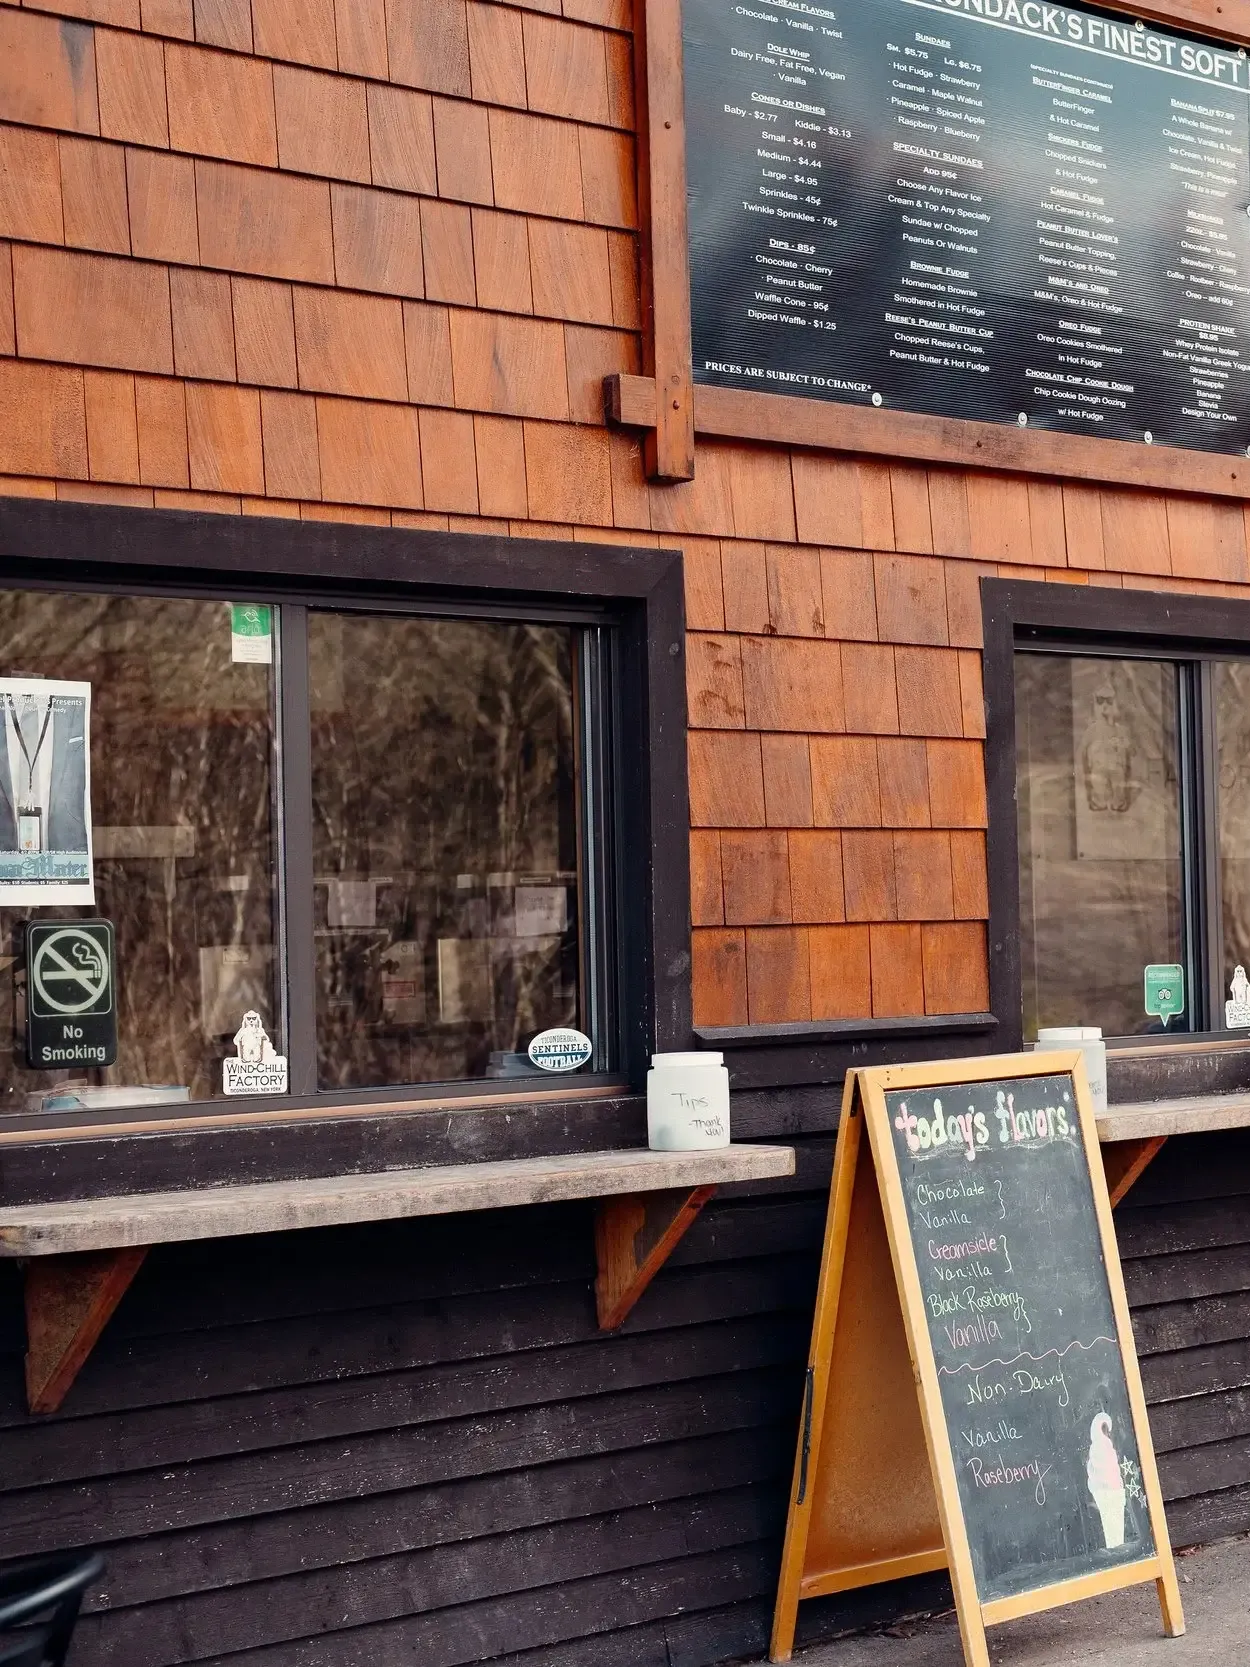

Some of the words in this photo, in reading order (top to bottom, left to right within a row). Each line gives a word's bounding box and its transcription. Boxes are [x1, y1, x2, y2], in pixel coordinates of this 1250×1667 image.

[736, 6, 778, 23] Chocolate
[785, 18, 814, 32] Vanilla
[821, 27, 843, 39] Twist
[767, 43, 788, 55] DOLE
[788, 48, 810, 61] WHIP
[905, 47, 929, 59] $5.75
[1087, 15, 1176, 65] FINEST
[1181, 45, 1242, 83] SOFT
[731, 48, 754, 63] Dairy
[780, 59, 794, 69] Fat
[819, 68, 846, 82] Vegan
[778, 73, 807, 86] Vanilla
[893, 62, 909, 72] Hot
[909, 66, 934, 79] Fudge
[940, 73, 981, 90] Strawberry
[751, 92, 781, 105] CONES
[795, 101, 826, 115] DISHES
[892, 79, 925, 94] Caramel
[931, 88, 955, 102] Maple
[956, 94, 983, 107] Walnut
[891, 97, 930, 113] Pineapple
[936, 107, 962, 120] Spiced
[963, 113, 985, 125] Apple
[724, 105, 746, 118] Baby
[754, 110, 778, 123] $2.77
[795, 119, 821, 132] Kiddie
[828, 126, 852, 139] $3.13
[898, 116, 938, 132] Raspberry
[944, 126, 981, 142] Blueberry
[761, 131, 786, 143] Small
[793, 138, 817, 150] $4.16
[757, 149, 791, 163] Medium
[798, 157, 822, 169] $4.44
[893, 142, 940, 160] SPECIALTY
[942, 152, 984, 169] SUNDAES
[762, 169, 787, 181] Large
[794, 174, 818, 186] $4.95
[759, 187, 798, 201] Sprinkles
[897, 178, 927, 191] Choose
[928, 184, 944, 196] Any
[945, 188, 969, 200] Flavor
[970, 192, 982, 202] Ice
[742, 201, 775, 215] Twinkle
[777, 208, 815, 223] Sprinkles
[888, 194, 915, 208] Cream
[924, 201, 940, 213] Top
[940, 205, 956, 217] Any
[957, 208, 991, 223] Specialty
[769, 239, 789, 250] DIPS
[902, 233, 935, 246] Peanuts
[948, 241, 978, 254] Walnuts
[755, 255, 798, 269] Chocolate
[805, 264, 833, 276] Cherry
[766, 275, 797, 288] Peanut
[798, 280, 823, 292] Butter
[901, 277, 946, 292] Homemade
[947, 286, 978, 298] Brownie
[754, 292, 782, 304] Waffle
[783, 297, 806, 308] Cone
[748, 309, 778, 323] Dipped
[780, 315, 806, 326] Waffle
[813, 320, 837, 330] $1.25
[894, 332, 930, 346] Chopped
[931, 338, 962, 351] Reese's
[1037, 334, 1055, 343] Oreo
[1056, 337, 1084, 347] Cookies
[889, 350, 918, 362] Peanut
[919, 354, 942, 365] Butter
[951, 358, 965, 368] Hot
[966, 361, 990, 373] Fudge
[705, 361, 742, 375] PRICES
[744, 367, 765, 378] ARE
[766, 370, 810, 385] SUBJECT
[811, 376, 825, 386] TO
[1034, 387, 1050, 396] Chip
[1052, 390, 1076, 399] Cookie
[1078, 394, 1100, 404] Dough
[1102, 397, 1126, 408] Oozing
[52, 698, 82, 706] Presents
[63, 1025, 84, 1039] No
[541, 1035, 577, 1044] TICONDEROGA
[42, 1045, 106, 1061] Smoking
[532, 1043, 588, 1053] SENTINELS
[537, 1054, 583, 1068] FOOTBALL
[228, 1075, 284, 1087] FACTORY
[671, 1092, 709, 1111] Tips
[895, 1098, 990, 1161] today's
[917, 1182, 985, 1205] Chocolate
[919, 1210, 972, 1229] Vanilla
[928, 1232, 998, 1260] Creamsicle
[934, 1263, 992, 1281] Vanilla
[927, 1290, 966, 1317] Black
[944, 1314, 1002, 1349] Vanilla
[962, 1420, 1022, 1448] Vanilla
